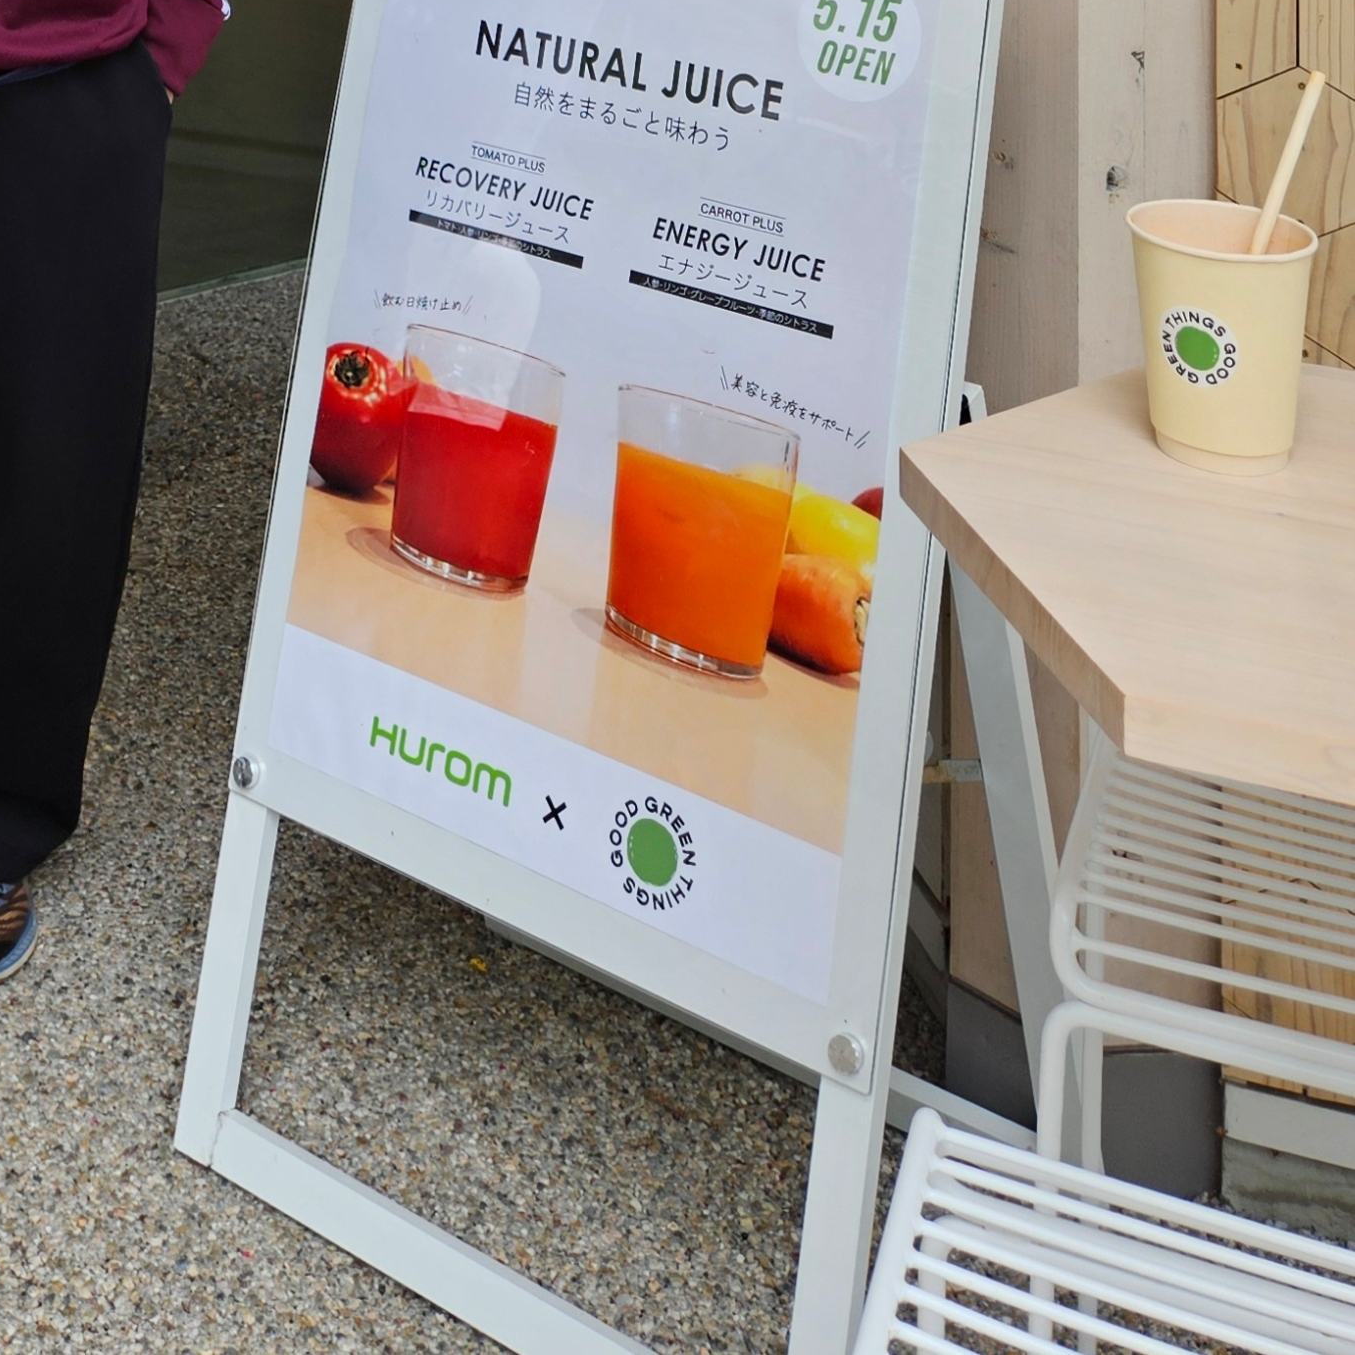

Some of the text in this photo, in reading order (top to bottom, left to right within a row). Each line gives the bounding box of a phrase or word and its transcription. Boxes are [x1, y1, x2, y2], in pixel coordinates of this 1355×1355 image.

[475, 19, 784, 121] NATURAL JUICE
[817, 40, 896, 85] OPEN
[514, 81, 730, 151] 自然をまるごと味わう
[415, 156, 594, 221] RECOVERY JUICE
[471, 145, 546, 173] TOMATO PLUS
[426, 189, 570, 244] リカバリージュース
[700, 203, 784, 233] CARROT PLUS
[652, 217, 826, 282] ENERGY JUICE
[658, 254, 808, 309] エナジージュース
[381, 292, 462, 312] 飲む日焼け止め
[1162, 311, 1236, 385] GOOD GREEN THINGS
[730, 373, 854, 442] 美容と免疫をサポート
[609, 796, 697, 911] GOOD GREEN THINGS
